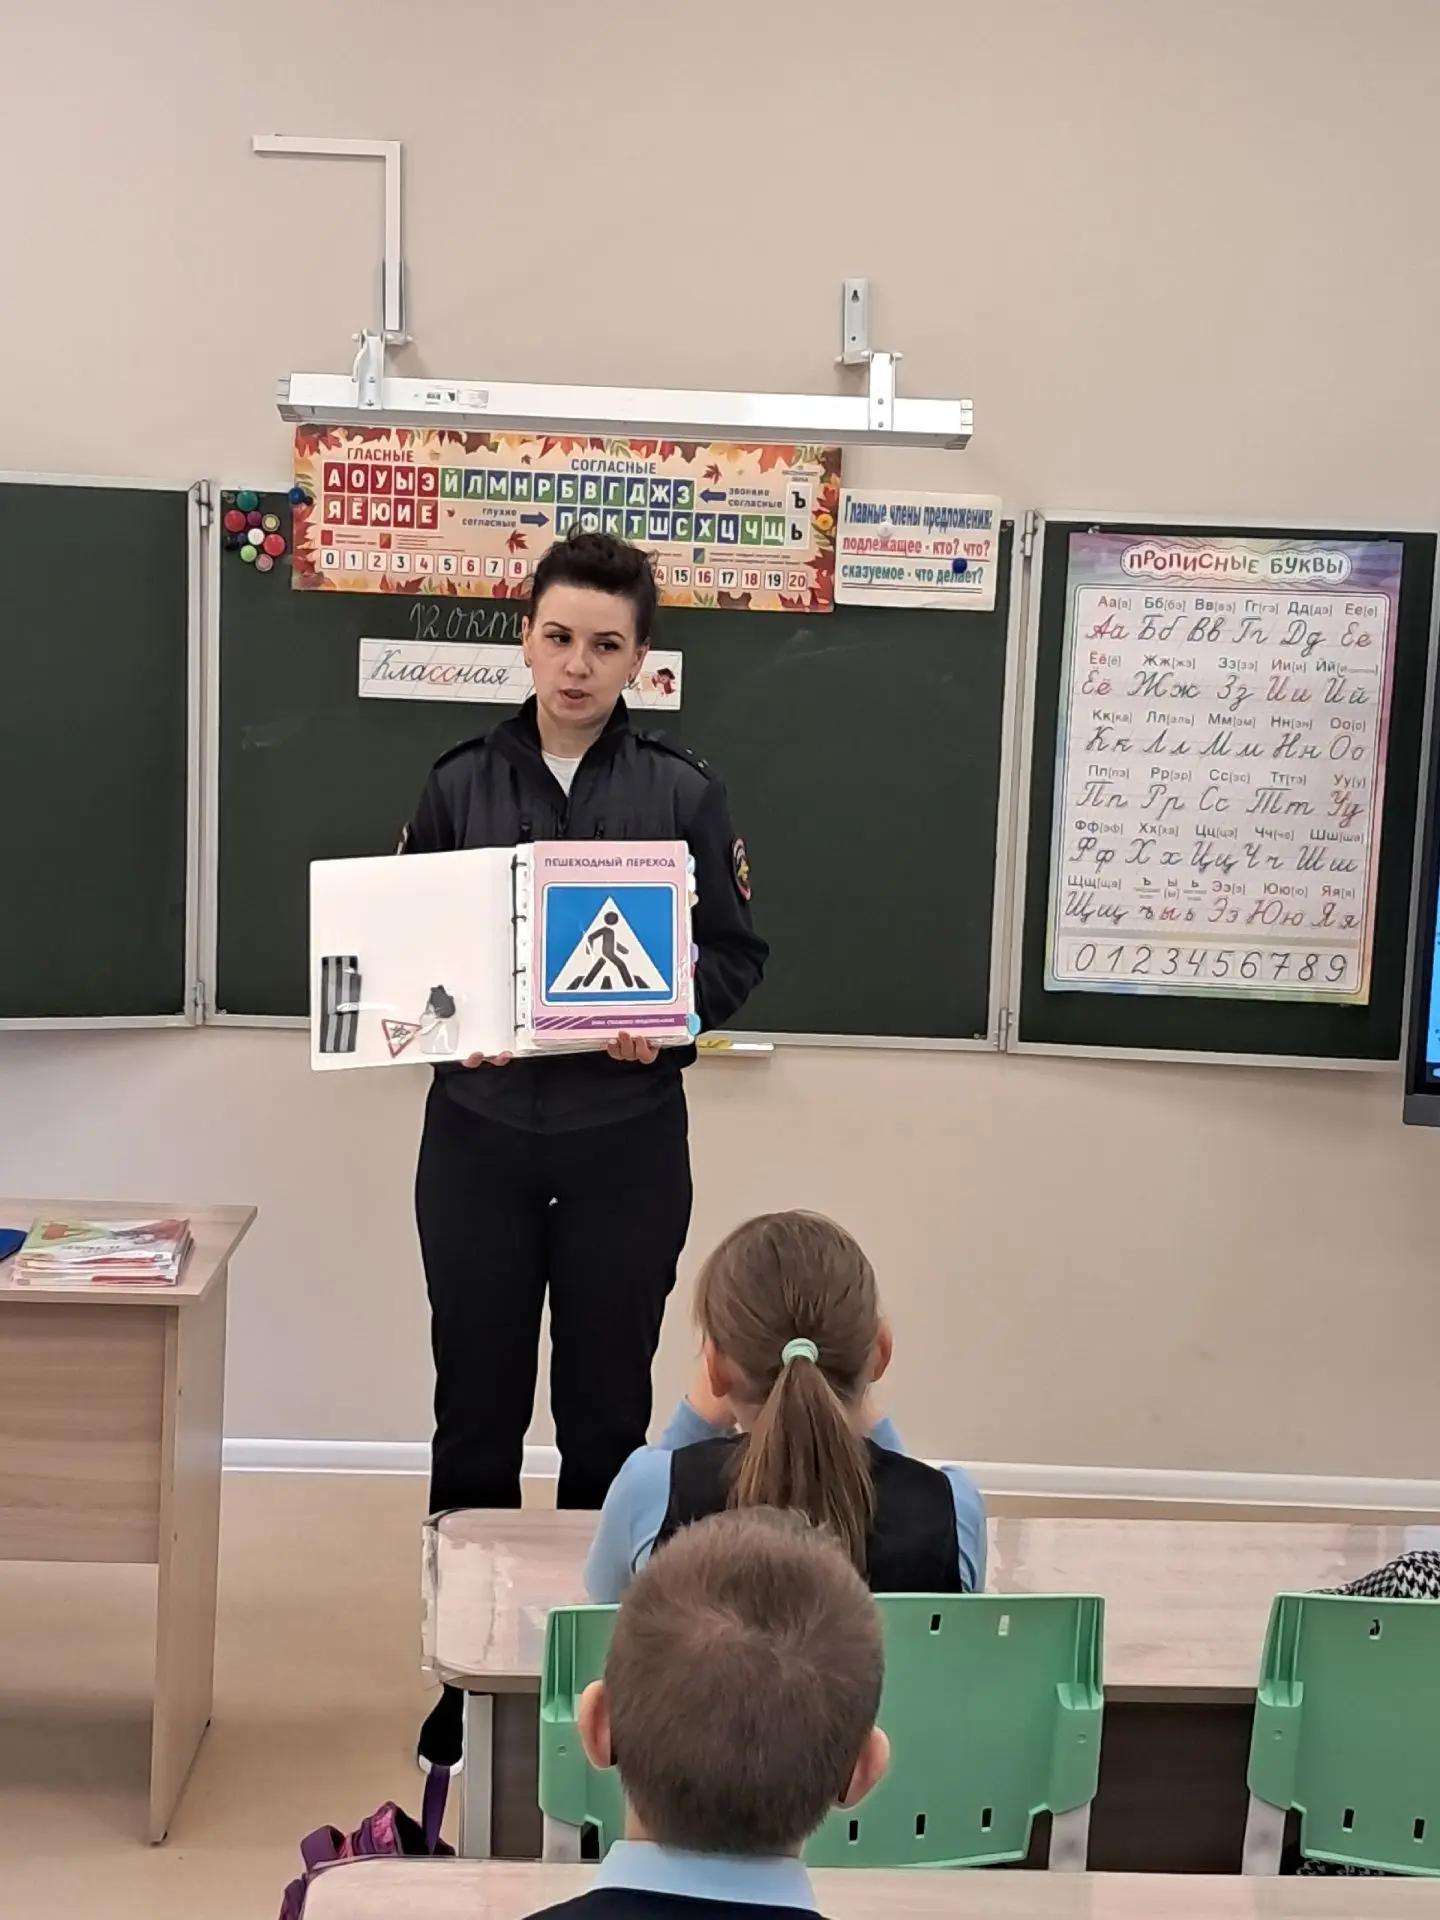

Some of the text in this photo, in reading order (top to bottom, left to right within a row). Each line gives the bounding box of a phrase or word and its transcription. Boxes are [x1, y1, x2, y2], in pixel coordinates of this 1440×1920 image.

[347, 448, 414, 462] ГЛАСНЫЕ
[571, 459, 657, 474] СОГЛАСНЫЕ
[728, 499, 783, 509] согласные
[792, 491, 806, 509] Ъ
[482, 507, 517, 517] глухие
[844, 495, 887, 524] Главные
[889, 506, 921, 526] члены
[462, 518, 517, 528] согласные
[791, 523, 803, 541] Ь
[843, 536, 922, 557] подлежащее
[933, 538, 960, 555] кто?
[963, 540, 991, 557] что?
[326, 553, 522, 574] 0 1 2 3 4 5 6 7 8
[1130, 550, 1343, 574] ПРОПИСНЫЕ БУКВЫ
[674, 569, 688, 582] 15
[698, 570, 711, 583] 16
[722, 571, 734, 584] 17
[745, 573, 758, 585] 18
[768, 574, 781, 587] 19
[789, 574, 806, 587] 20
[842, 563, 905, 584] сказуемое
[915, 568, 933, 582] что
[409, 602, 523, 639] 12 окт
[371, 649, 509, 685] Классная
[544, 857, 676, 868] ПЕШЕХОДНЫЙ ПЕРЕХОД
[1075, 943, 1347, 982] 0 1 2 3 4 5 6 7 8 9
